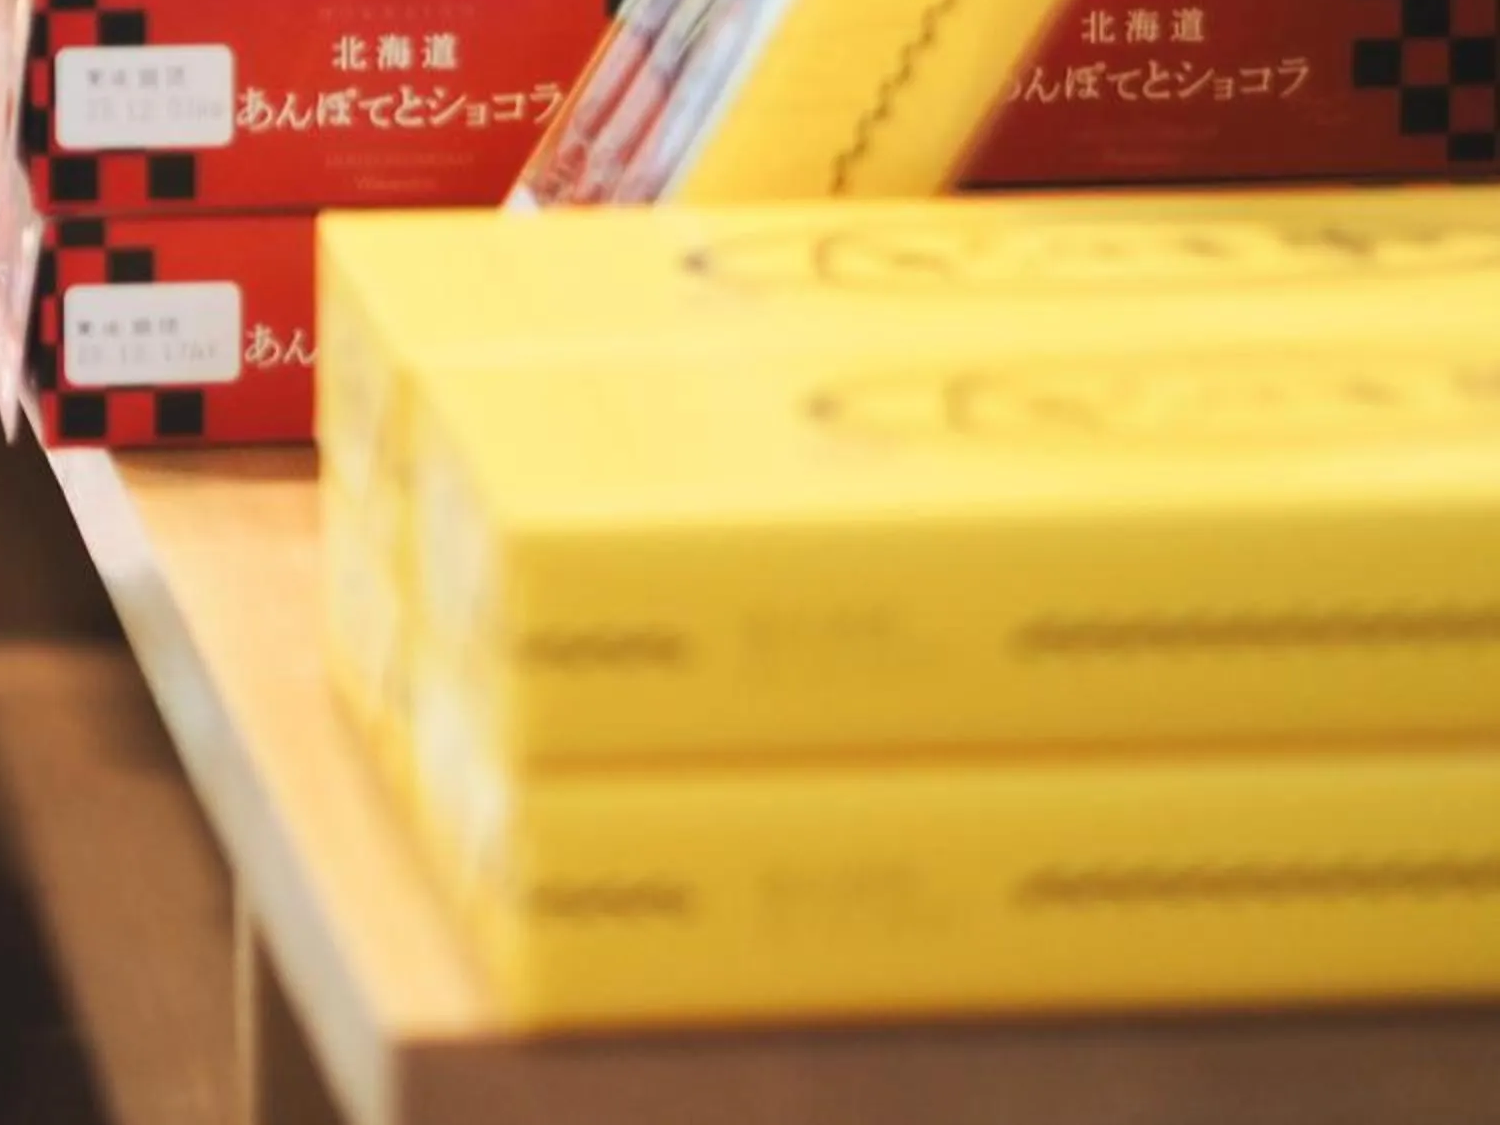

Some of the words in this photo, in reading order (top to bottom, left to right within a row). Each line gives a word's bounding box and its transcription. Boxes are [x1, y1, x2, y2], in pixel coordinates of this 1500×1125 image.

[1080, 6, 1206, 45] 北海道
[331, 32, 458, 70] 北海道
[236, 81, 568, 130] あんぽてとショコラ
